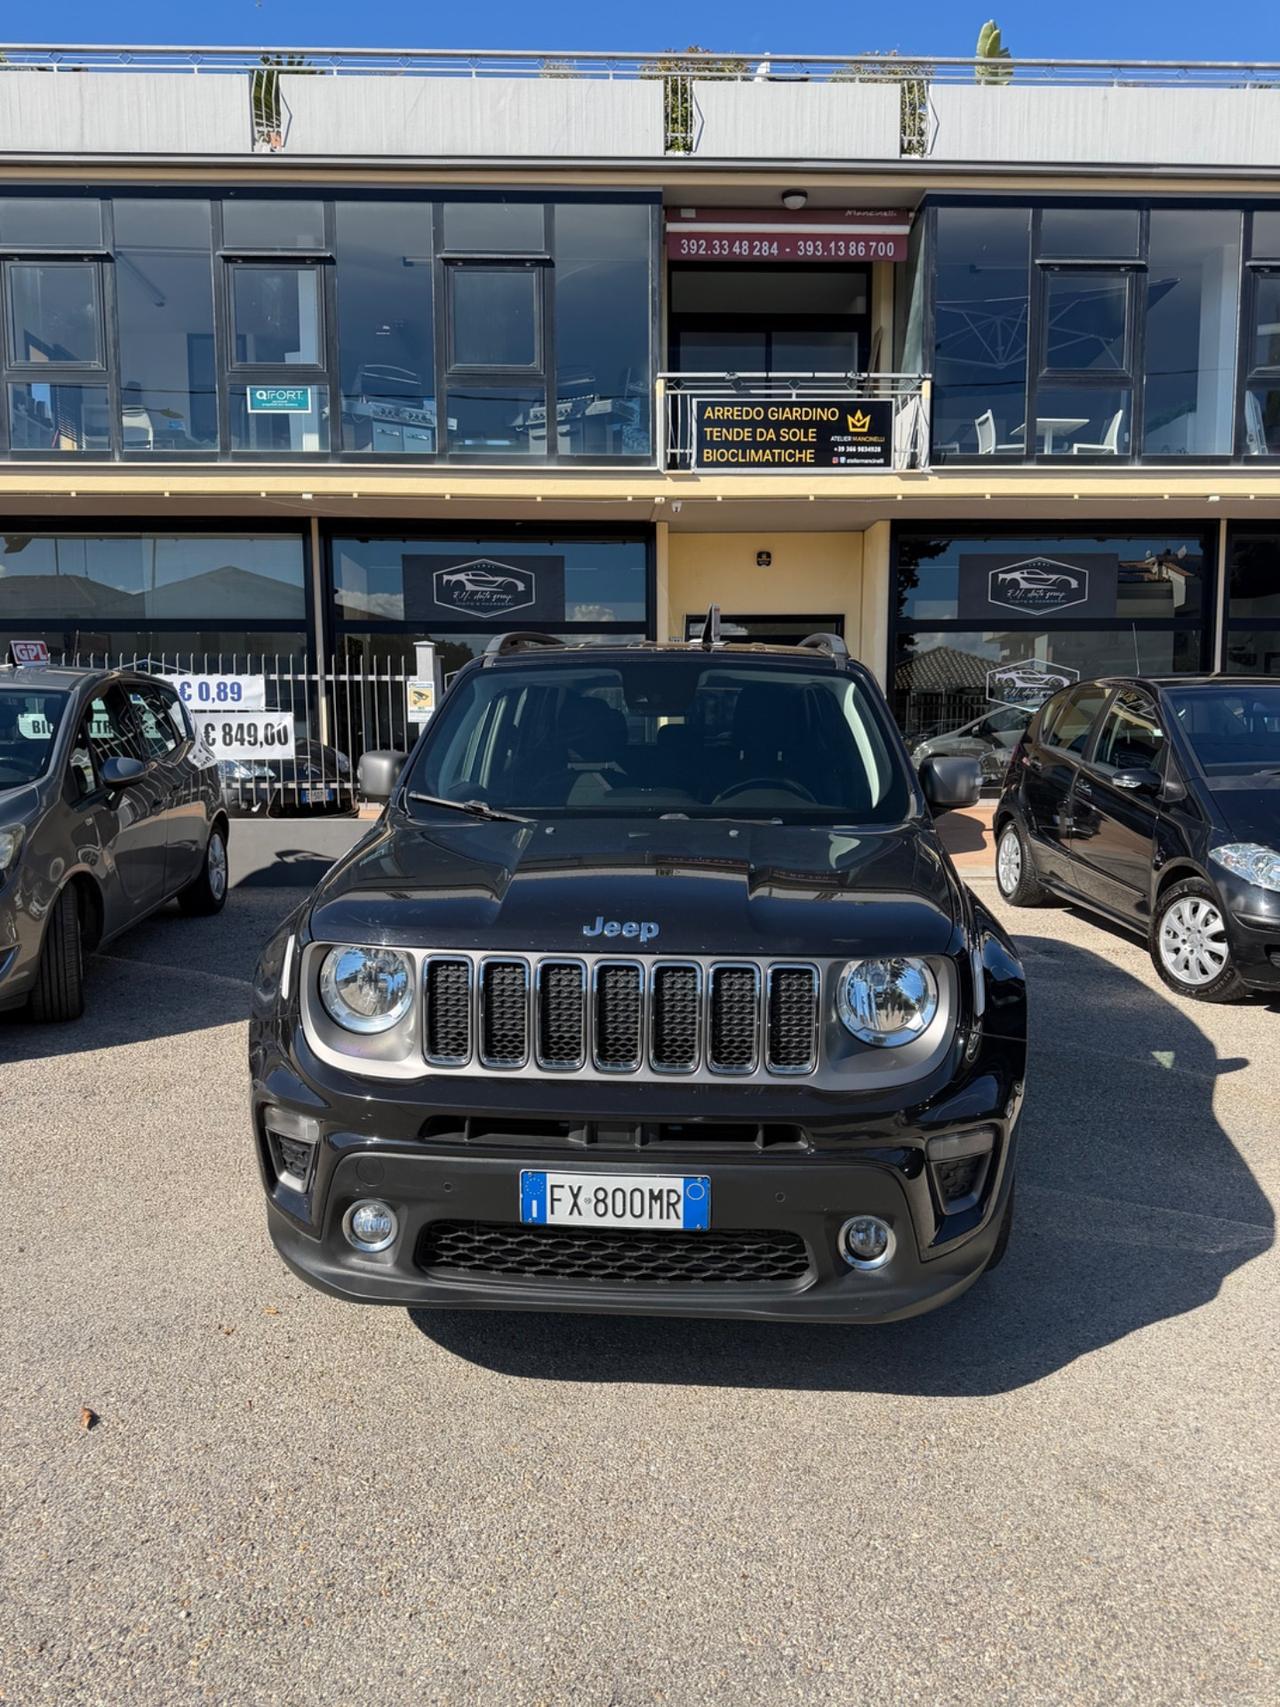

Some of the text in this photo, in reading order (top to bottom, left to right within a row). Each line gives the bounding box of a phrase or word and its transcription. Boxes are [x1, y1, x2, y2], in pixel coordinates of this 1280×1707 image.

[704, 406, 839, 421] ARREDO GIARDINO
[704, 427, 817, 442] TENDE DA SOLE
[703, 448, 815, 463] BIOCLIMATICHE
[15, 644, 48, 660] GPL
[179, 681, 242, 703] € 0,89
[204, 723, 289, 748] € 849,00
[582, 916, 660, 942] Jeep
[593, 1187, 681, 1220] 800MR
